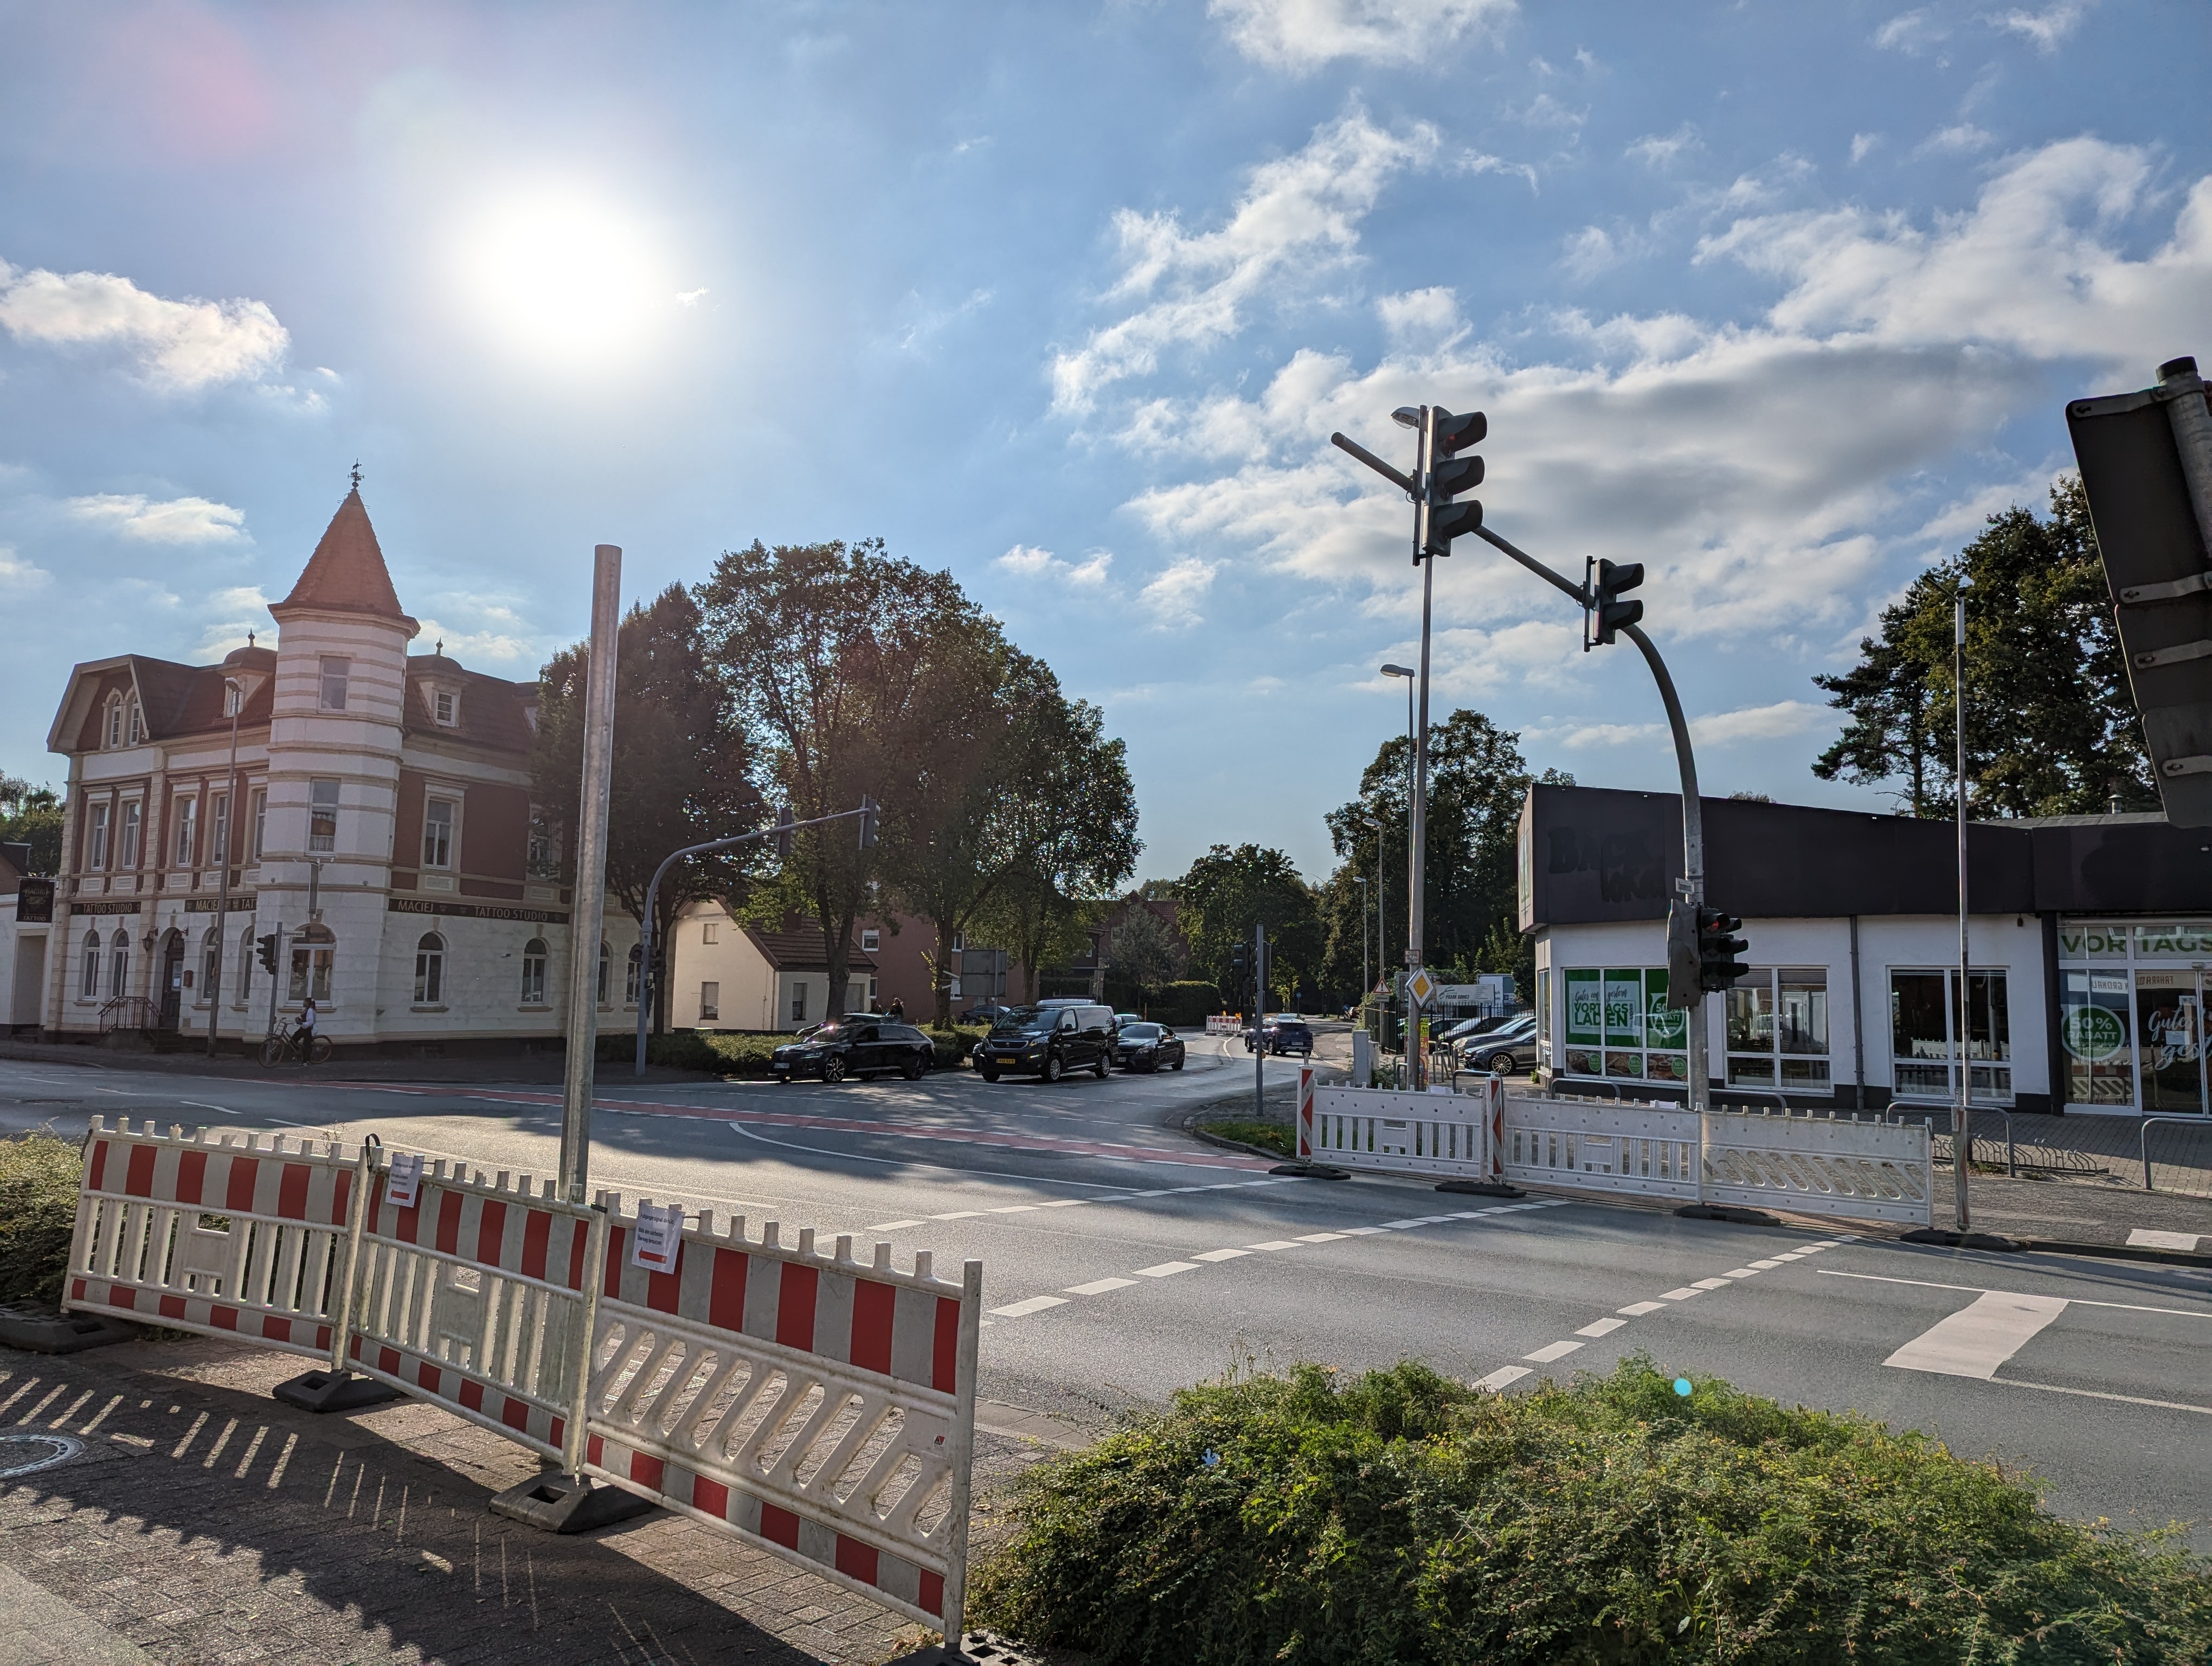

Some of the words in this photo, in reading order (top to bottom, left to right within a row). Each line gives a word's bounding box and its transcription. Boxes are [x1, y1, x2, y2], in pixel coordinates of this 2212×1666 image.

[83, 904, 106, 913] TATTOO
[108, 903, 132, 913] STUDIO
[398, 900, 433, 912] MACIEJ
[475, 906, 510, 918] TATTOO
[513, 910, 548, 921] STUDIO
[1575, 989, 1589, 1002] Gutes
[1606, 985, 1628, 1003] gestern
[1574, 1012, 1628, 1027] LADEN
[2149, 1005, 2196, 1041] Gutes
[2067, 1031, 2117, 1040] RABATT
